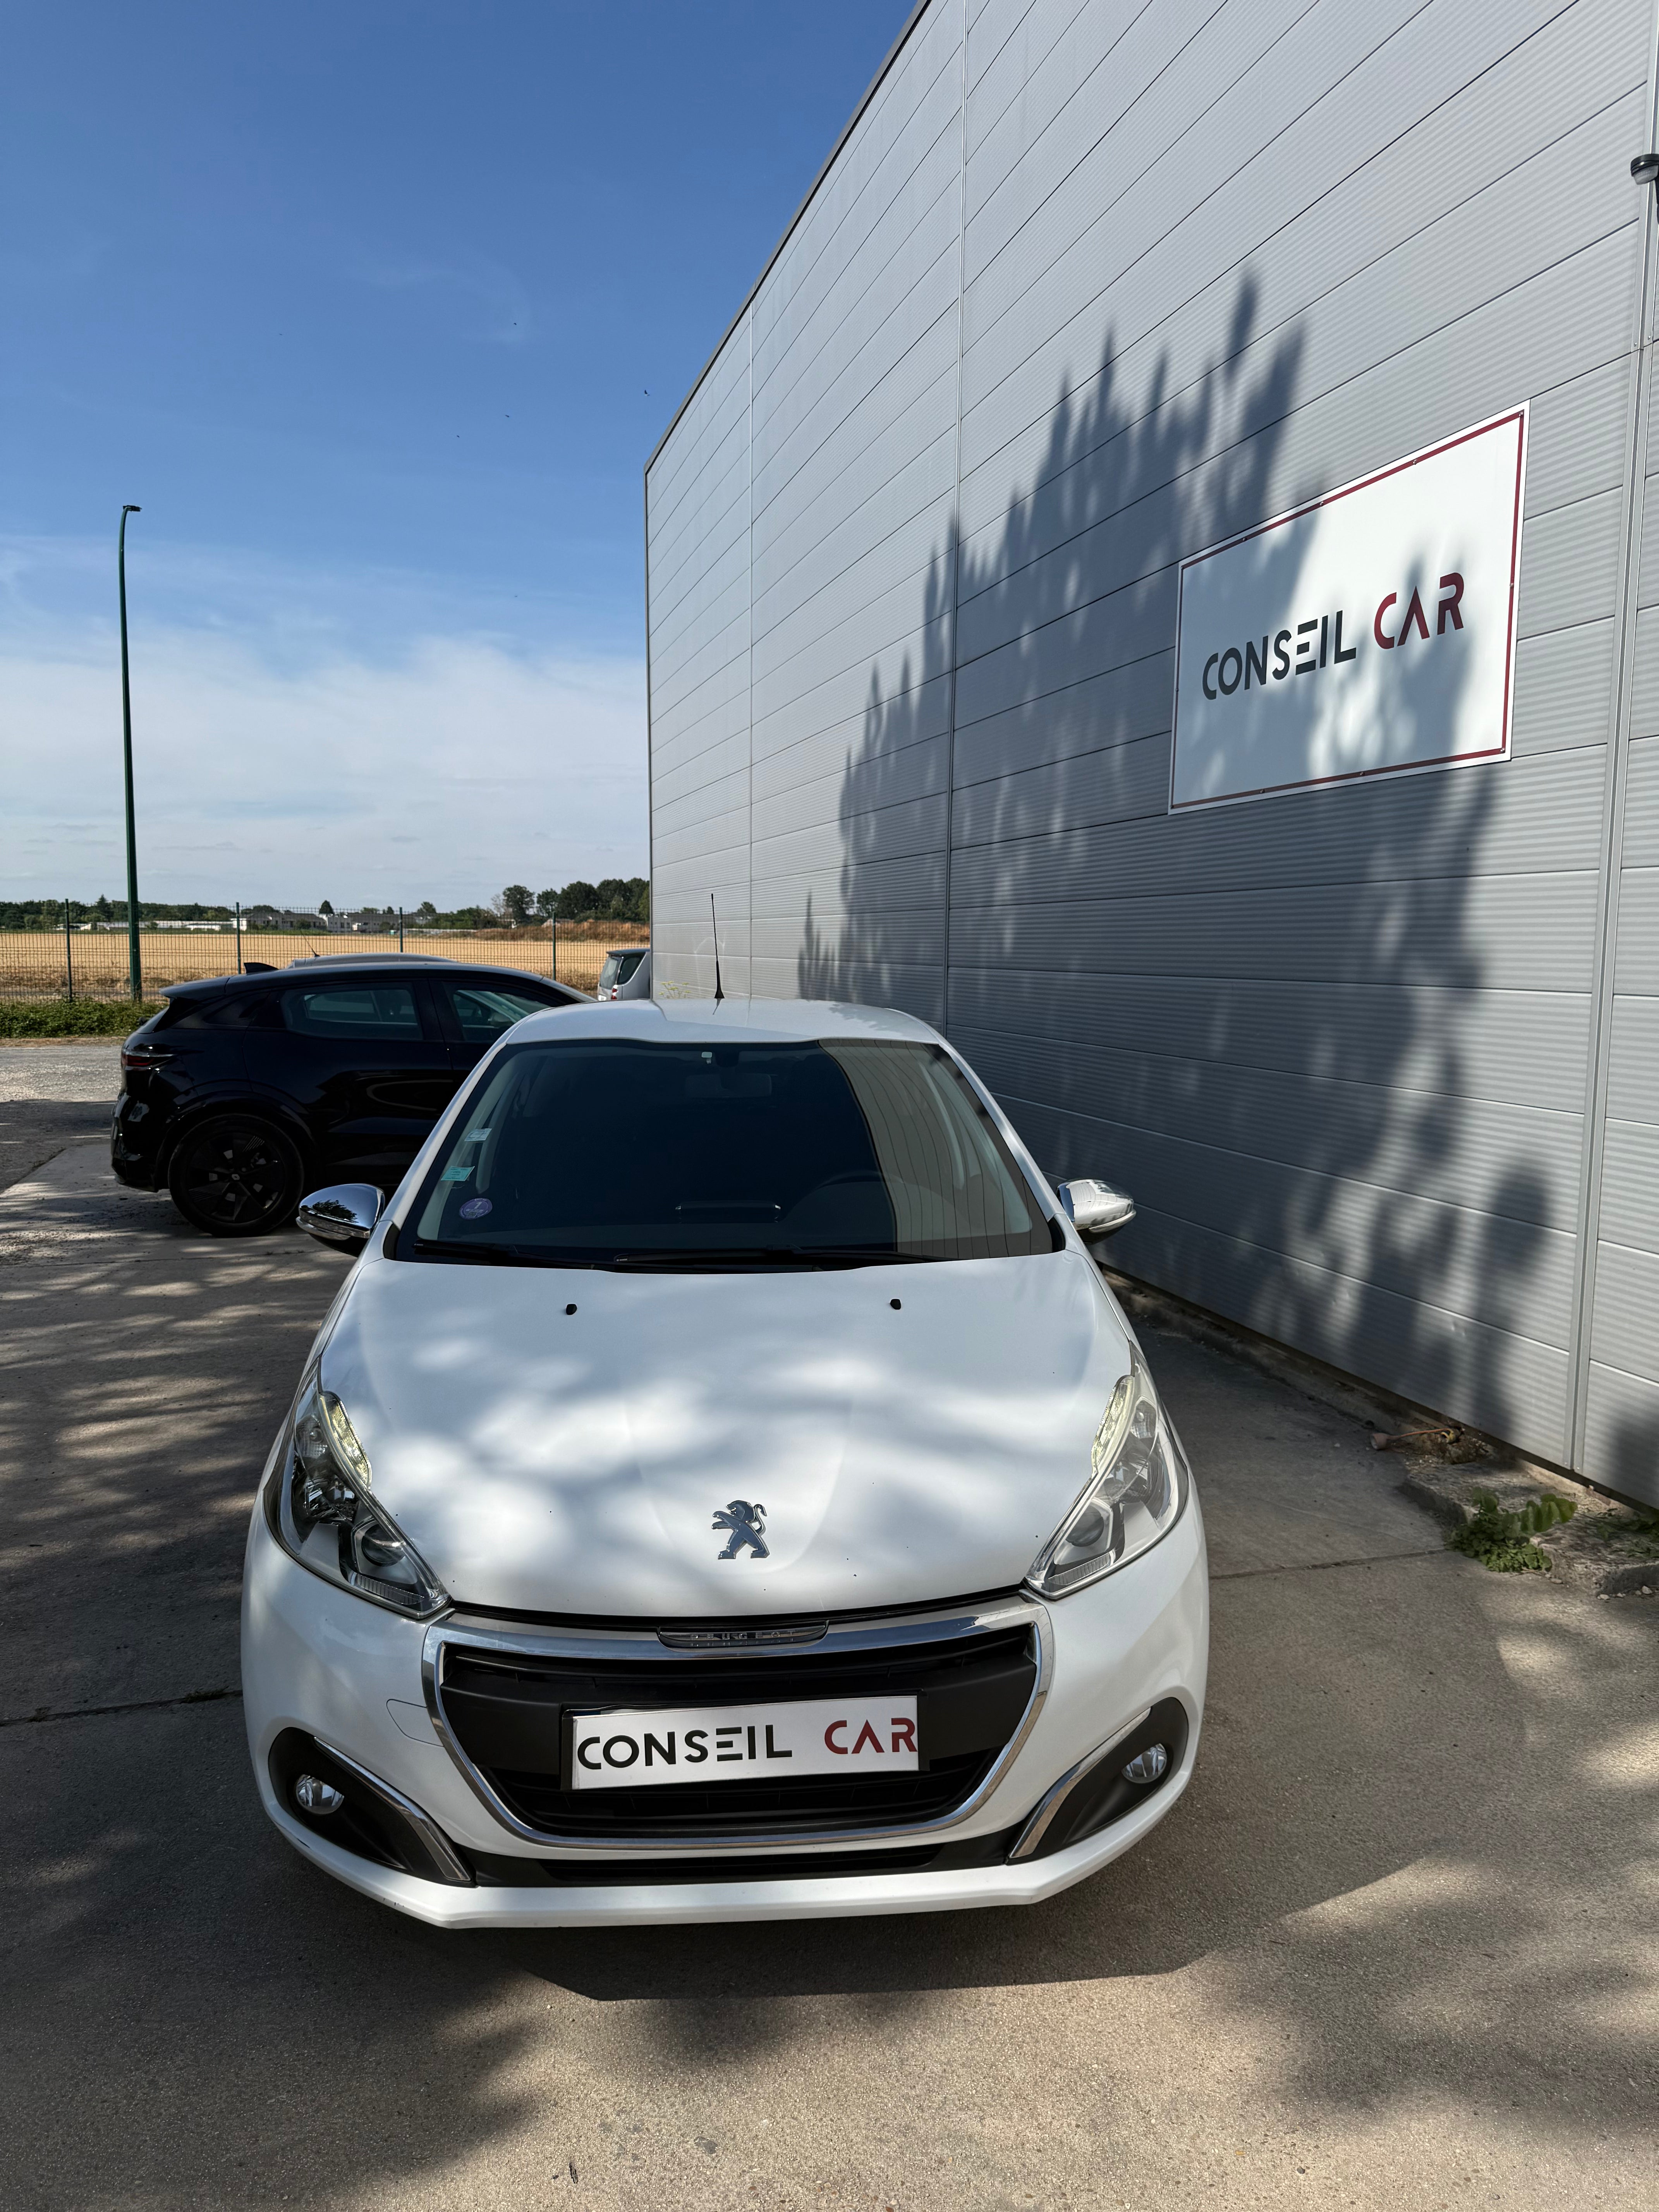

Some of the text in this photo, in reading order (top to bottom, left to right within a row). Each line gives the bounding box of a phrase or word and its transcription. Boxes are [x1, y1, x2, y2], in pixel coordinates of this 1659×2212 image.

[1202, 572, 1464, 700] CONSEIL CAR
[577, 1717, 918, 1770] CONSEIL CAR
